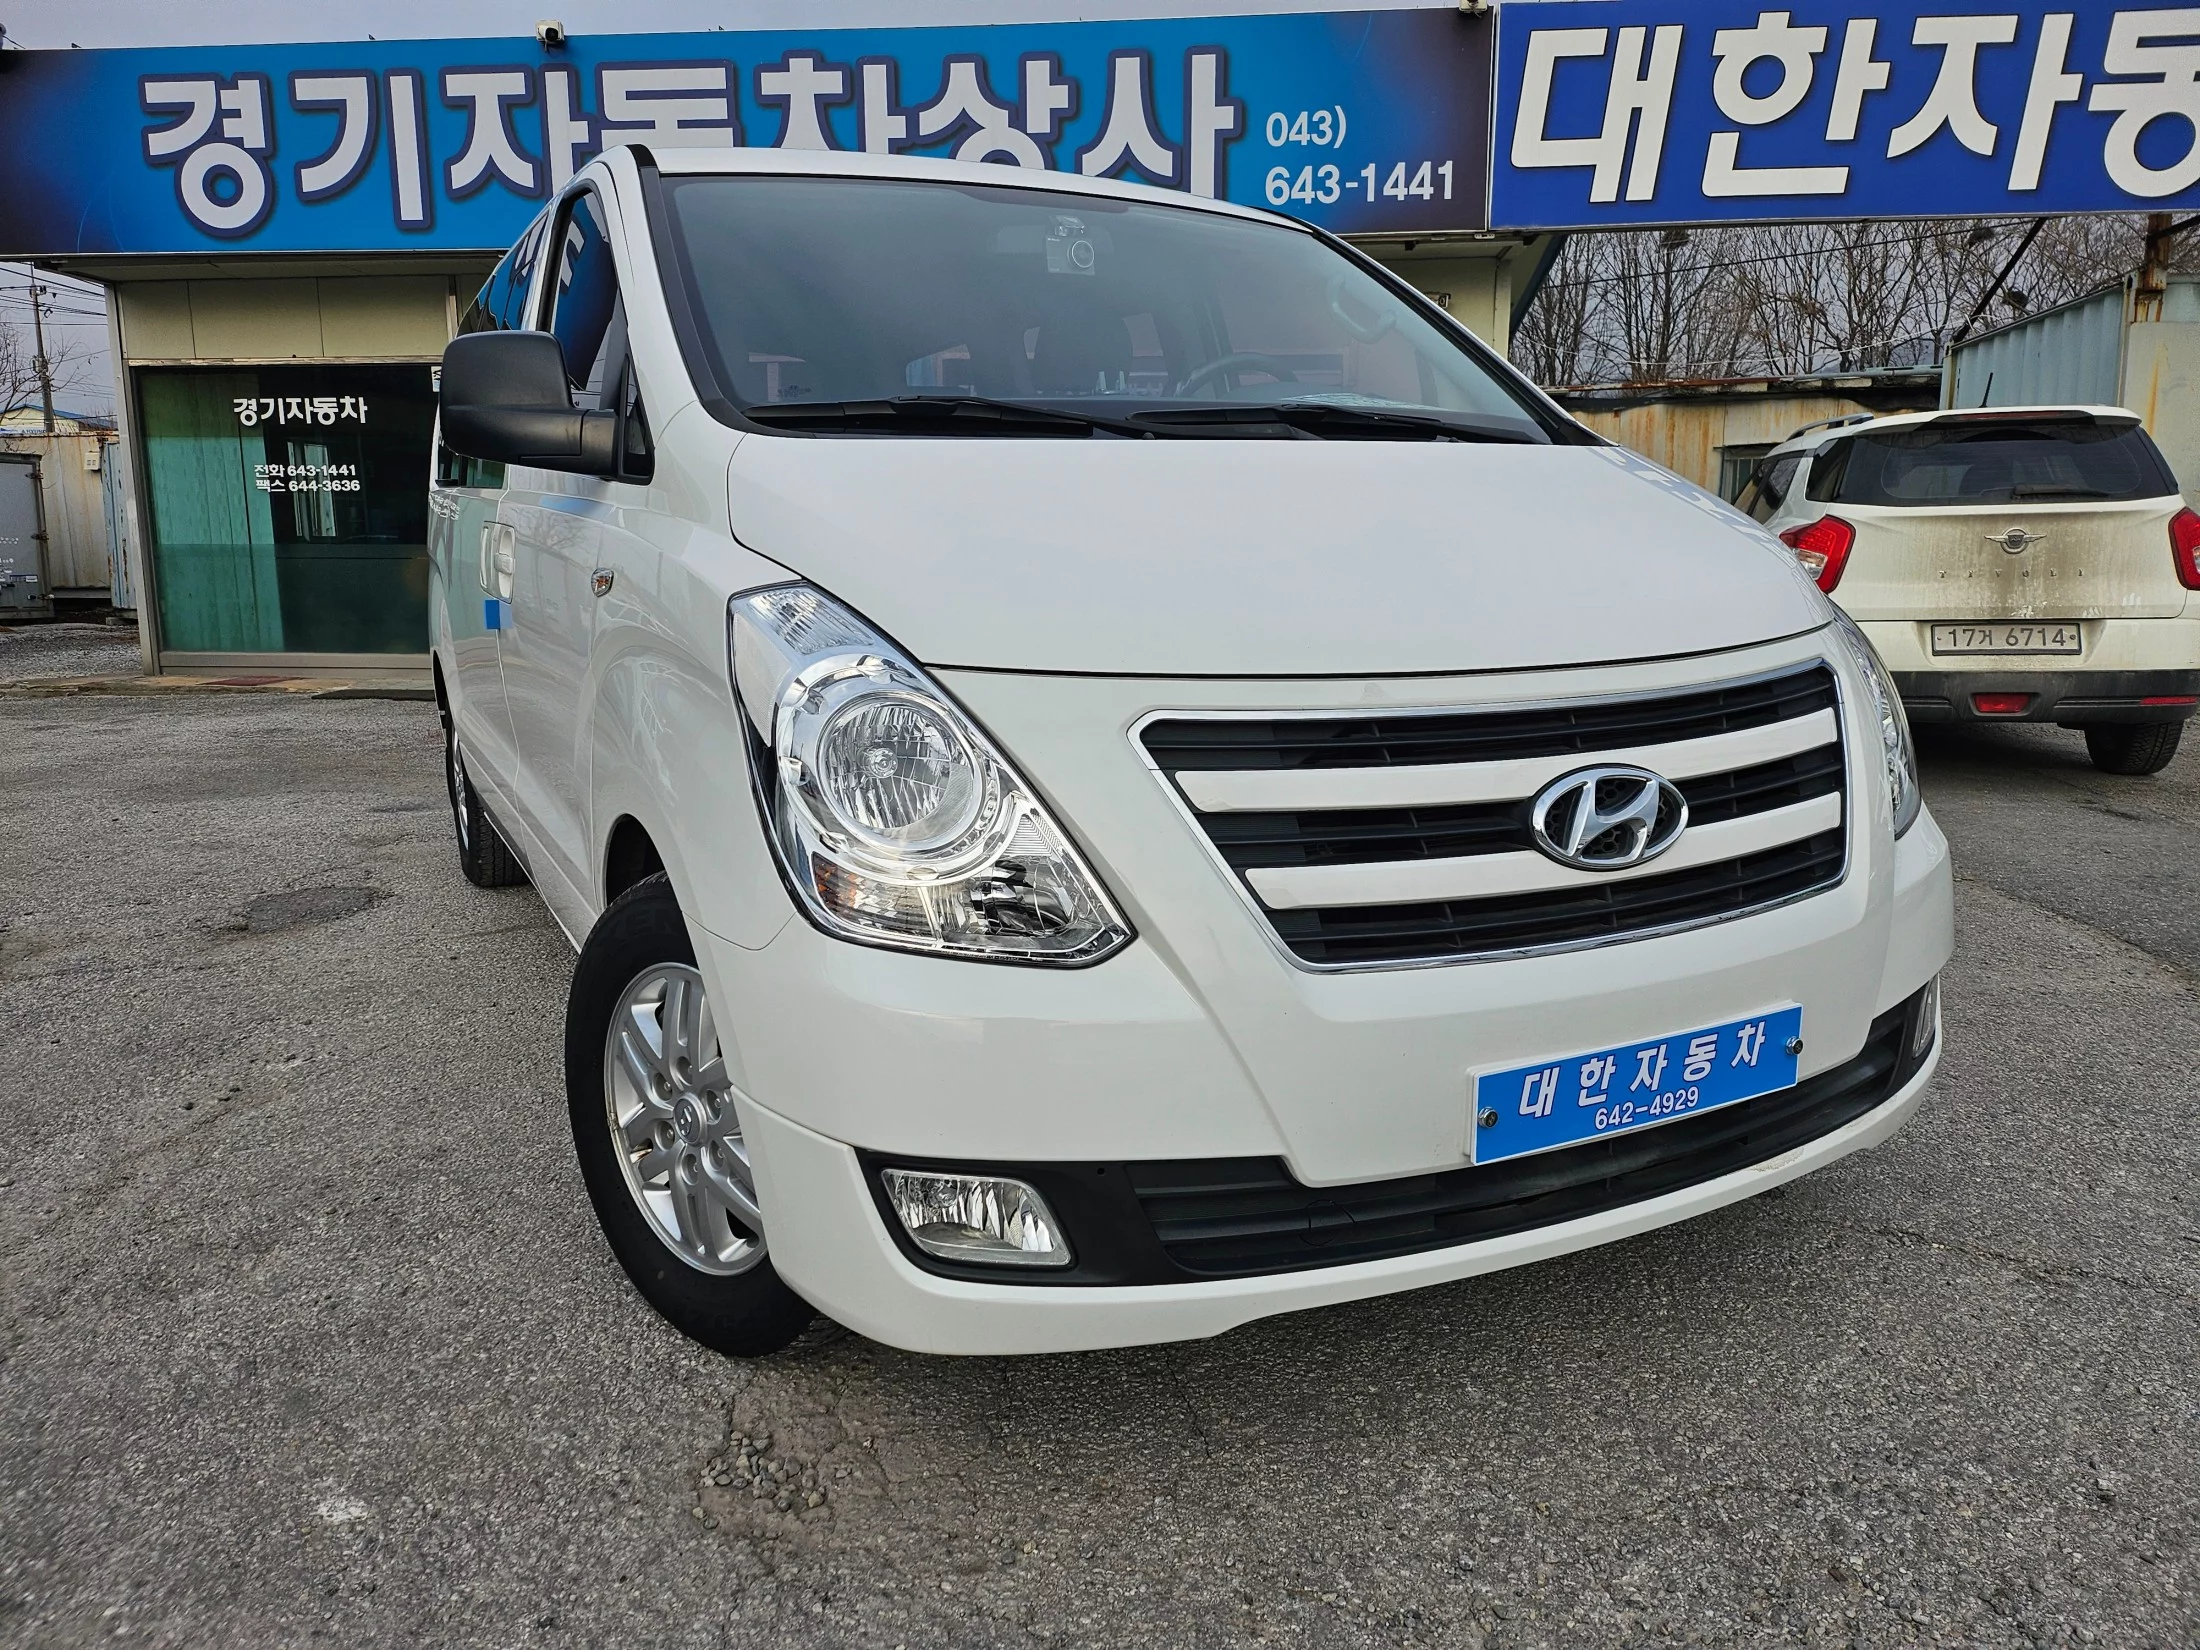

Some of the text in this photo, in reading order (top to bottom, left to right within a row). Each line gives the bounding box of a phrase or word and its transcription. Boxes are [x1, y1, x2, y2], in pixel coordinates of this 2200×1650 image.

[1265, 106, 1346, 149] 043)
[1265, 160, 1454, 205] 643-1441
[233, 396, 368, 426] 경기자동차
[254, 464, 356, 478] 전화 643-1441
[255, 479, 361, 493] 팩스 644-3636
[1939, 568, 2084, 579] TYVOLI
[1948, 627, 2067, 647] 17거 6714
[1594, 1086, 1699, 1130] 642-4929
